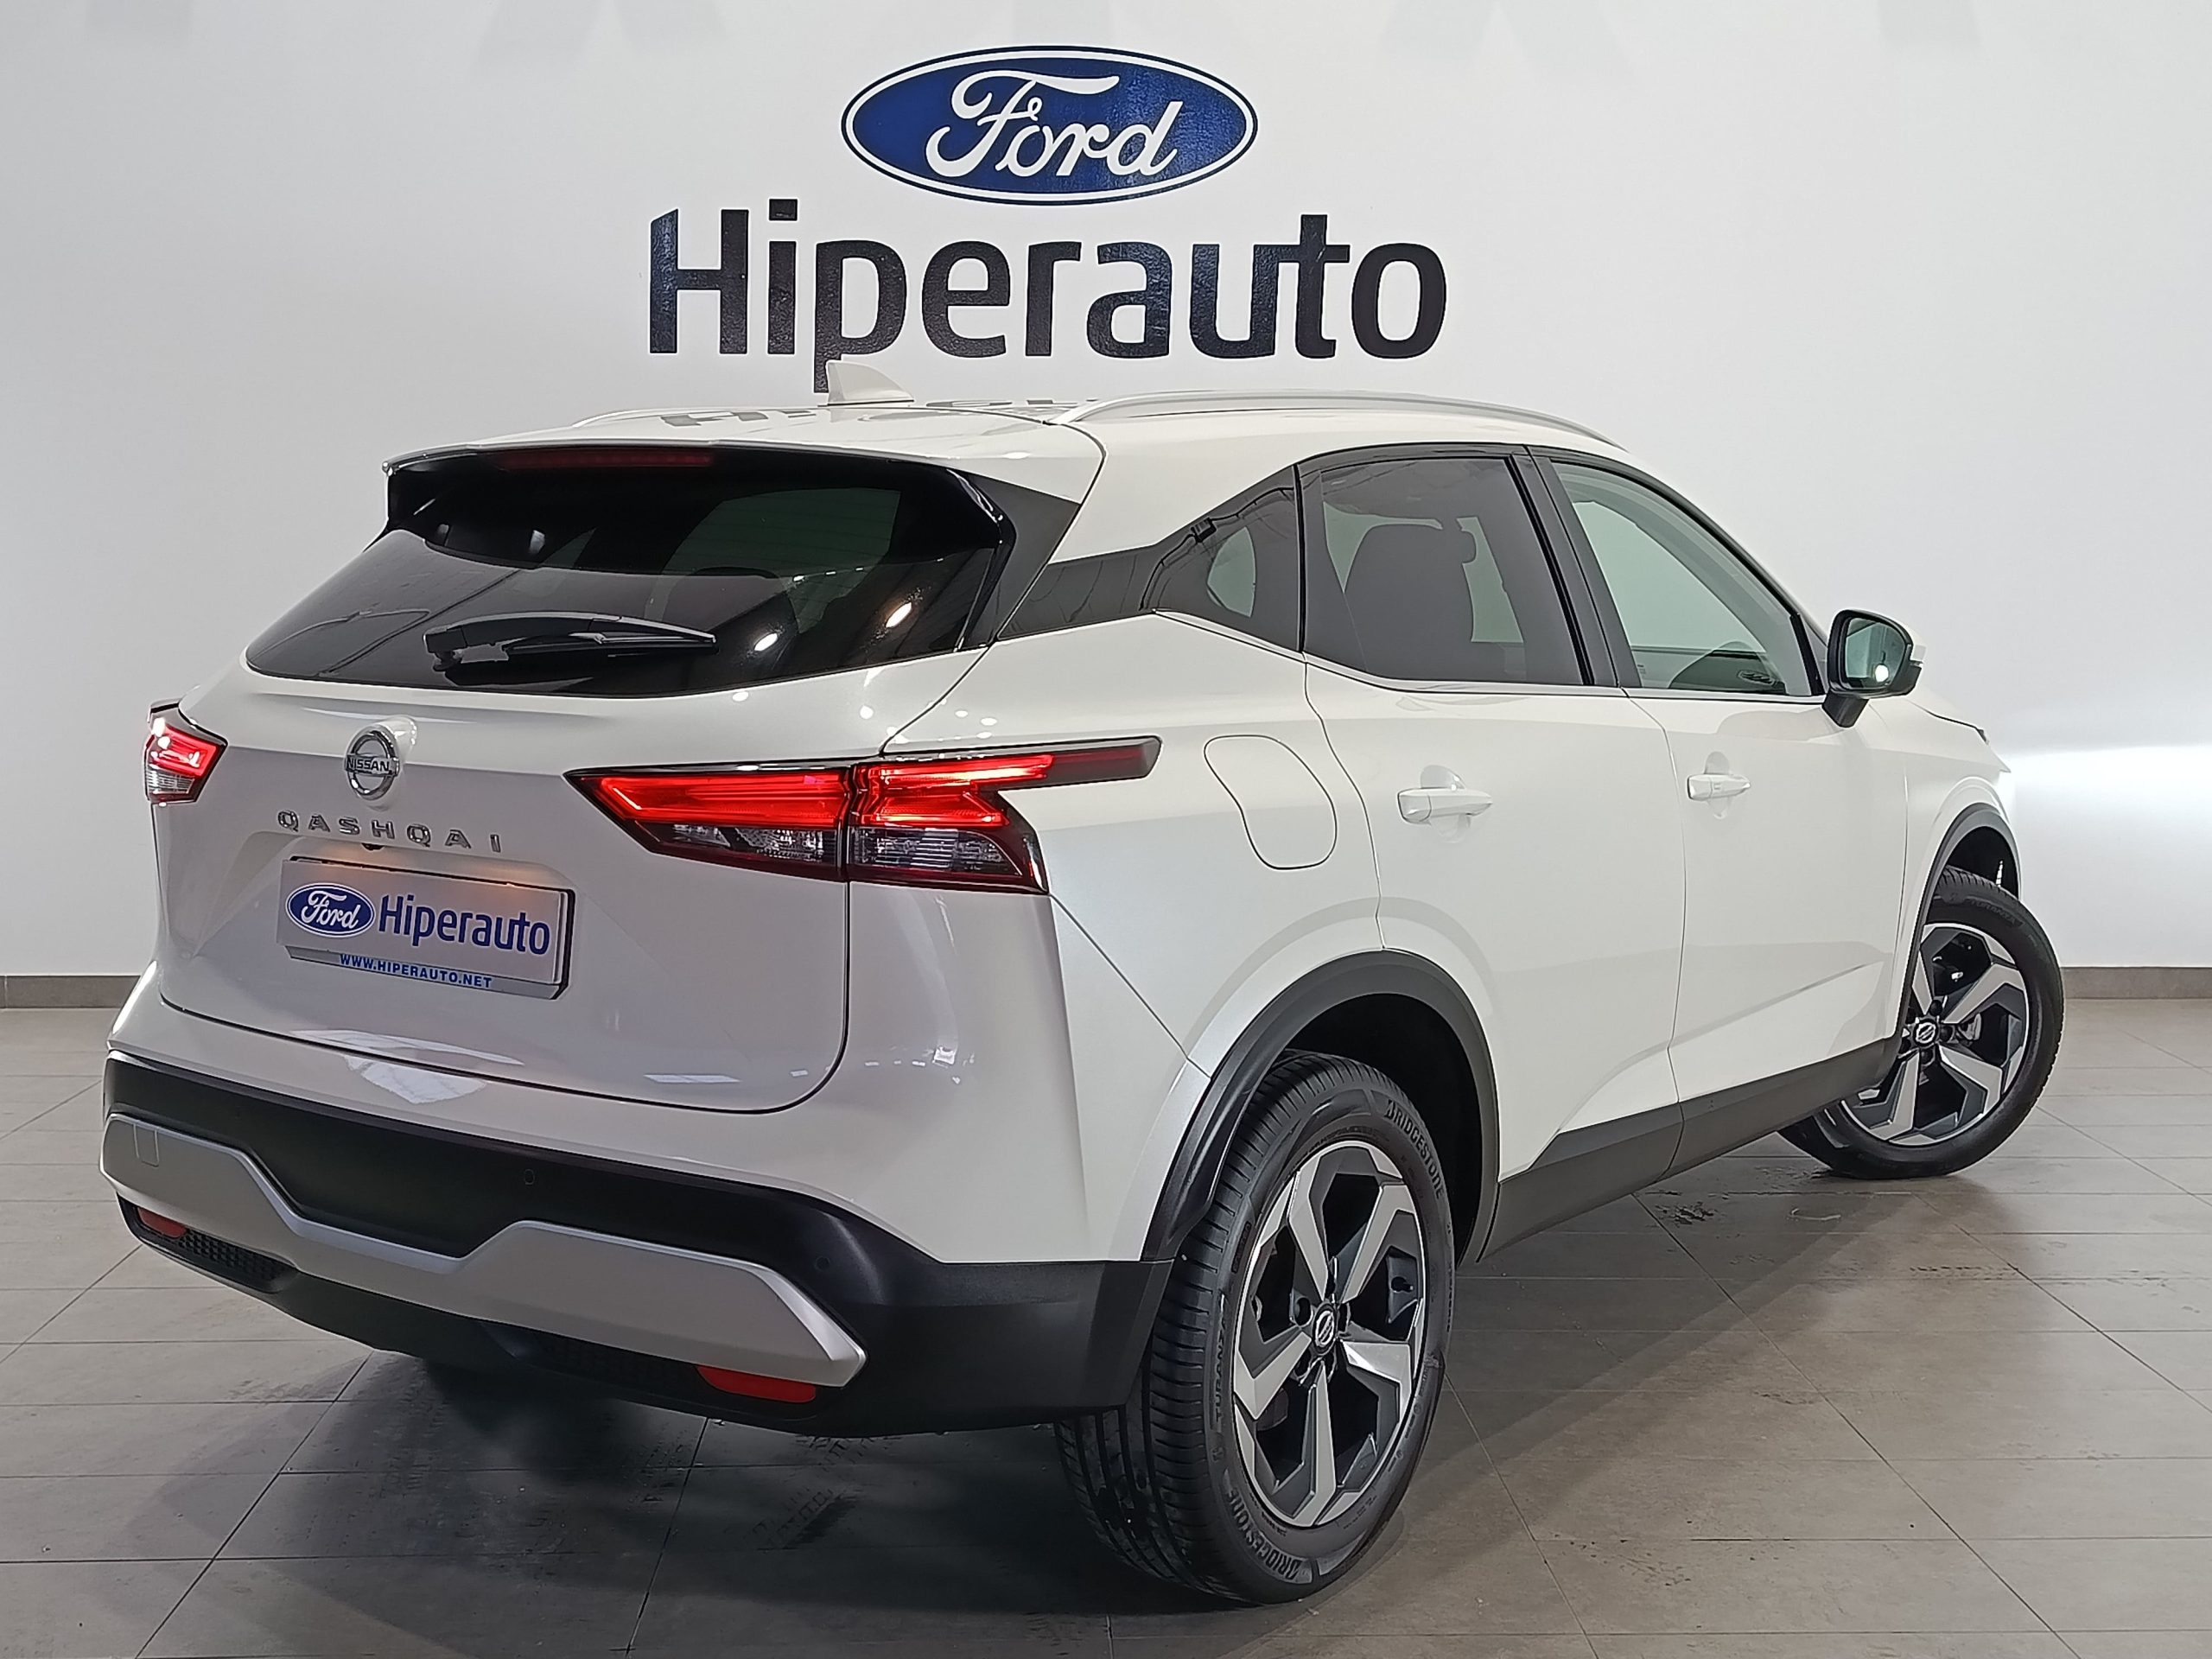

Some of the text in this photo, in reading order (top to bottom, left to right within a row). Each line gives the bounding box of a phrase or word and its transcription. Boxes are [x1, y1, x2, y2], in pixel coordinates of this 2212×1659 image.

[925, 69, 1183, 178] Ford
[649, 199, 1447, 393] Hiperauto
[346, 754, 391, 772] NISSAN
[277, 810, 501, 854] QASHQAI
[302, 890, 550, 955] Ford Hiperauto
[340, 953, 493, 988] WWW.HIPERAUTO.NET
[1384, 1099, 1445, 1200] BRIDGESTONE
[1225, 1488, 1303, 1580] BRIDGESTONE
